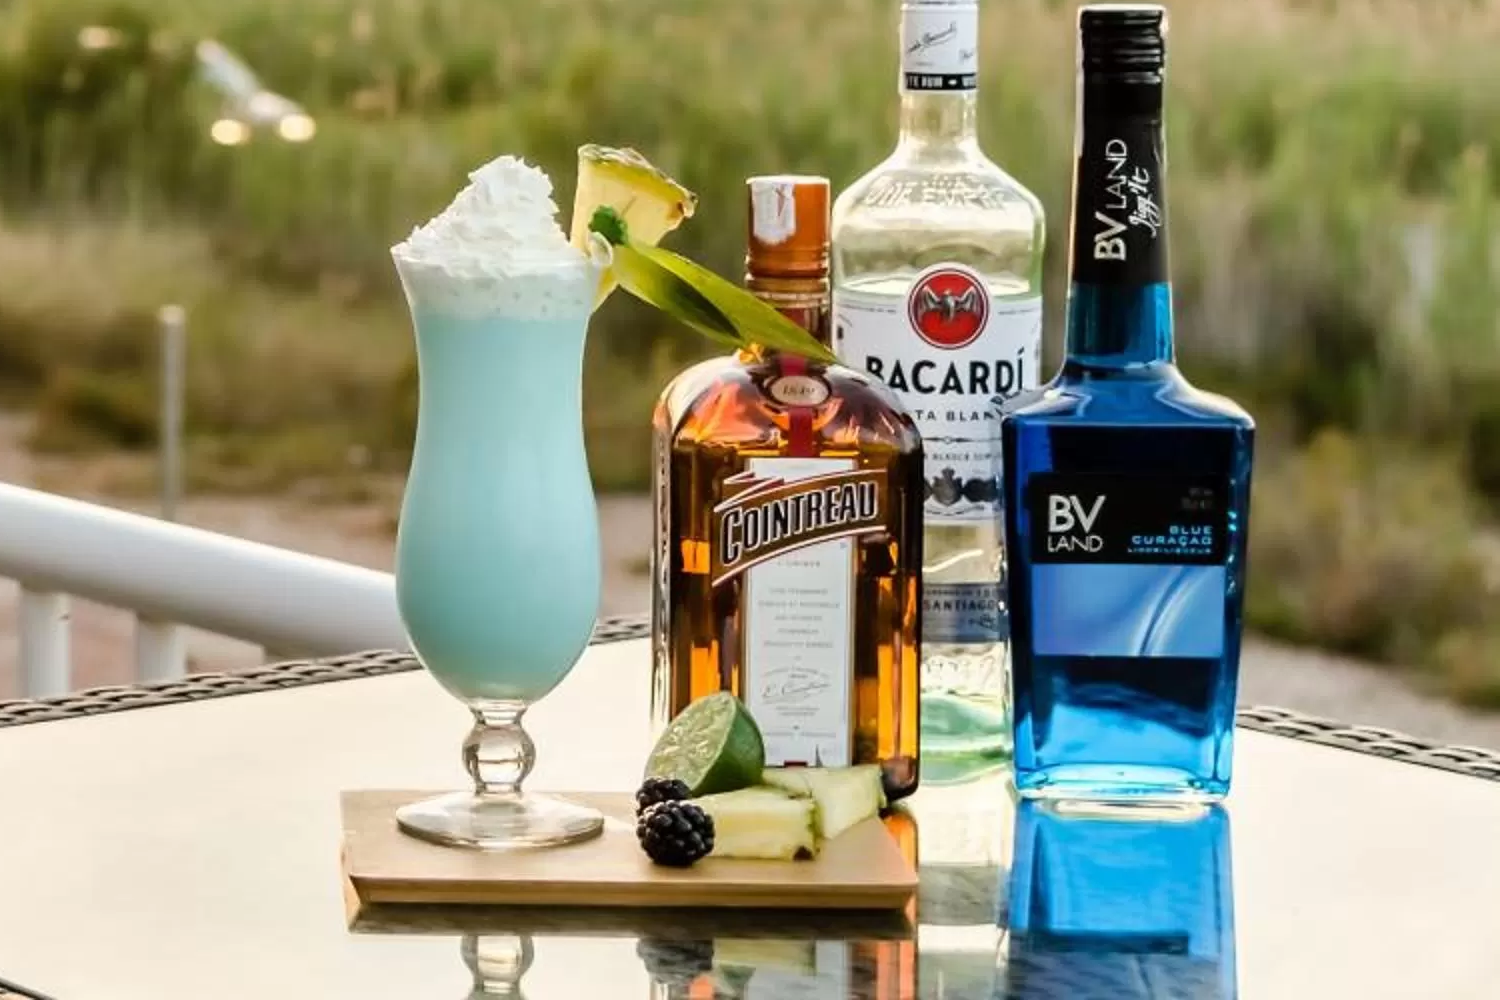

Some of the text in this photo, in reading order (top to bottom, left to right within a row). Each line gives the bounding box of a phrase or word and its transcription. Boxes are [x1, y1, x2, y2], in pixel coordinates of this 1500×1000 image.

[1093, 138, 1128, 261] BV LAND
[865, 346, 1025, 395] BACARDÍ
[720, 479, 879, 567] COINTREAU
[1048, 495, 1107, 534] BV
[1169, 525, 1213, 535] BLUE
[1047, 535, 1104, 553] LAND
[1131, 535, 1213, 547] CURAÇAO
